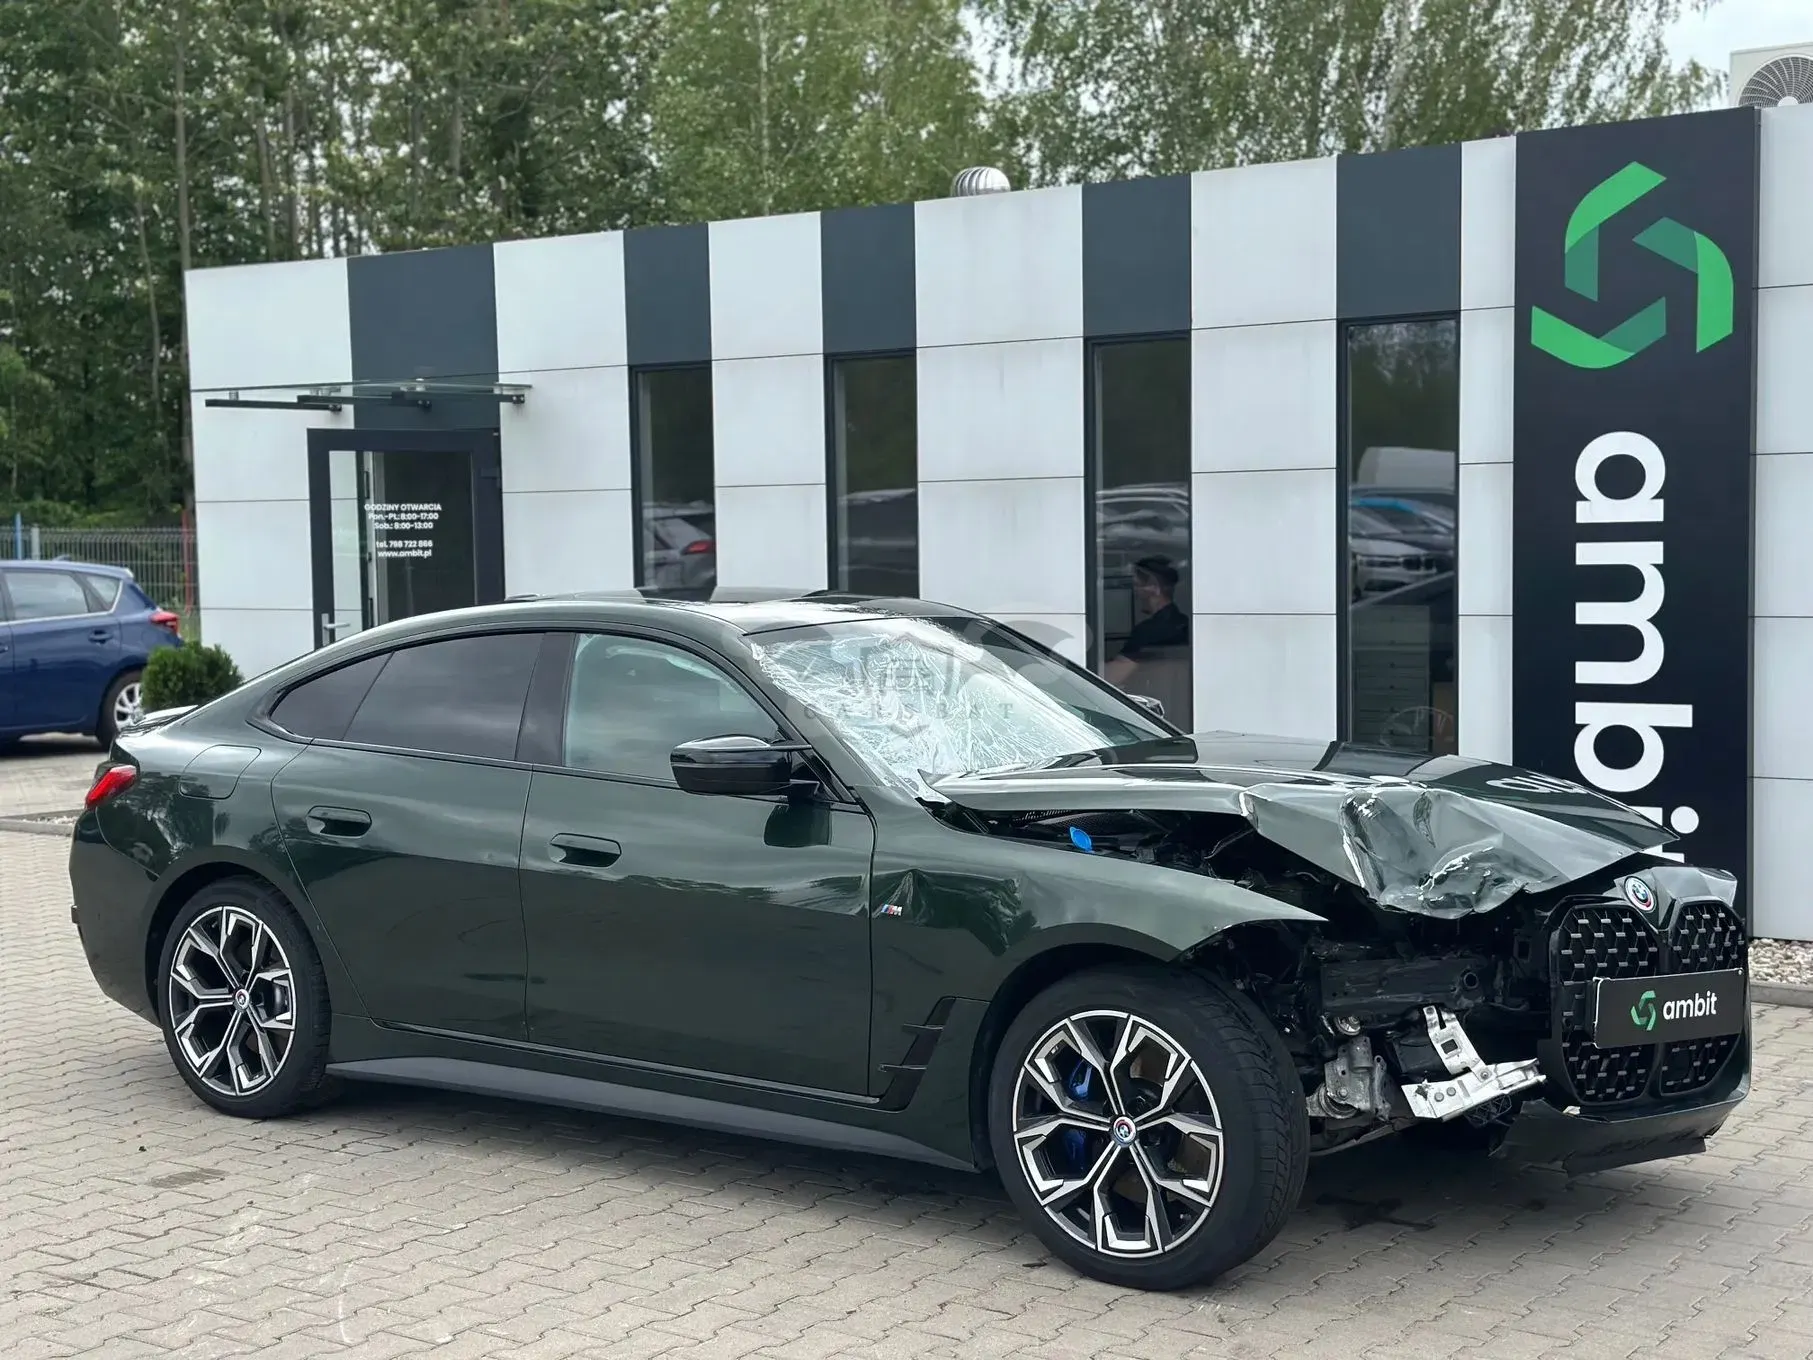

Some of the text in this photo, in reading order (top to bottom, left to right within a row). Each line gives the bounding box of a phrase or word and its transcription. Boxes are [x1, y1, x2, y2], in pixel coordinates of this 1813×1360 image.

[364, 503, 442, 511] GODZINY OTWARCIA
[1662, 990, 1718, 1020] ambit
